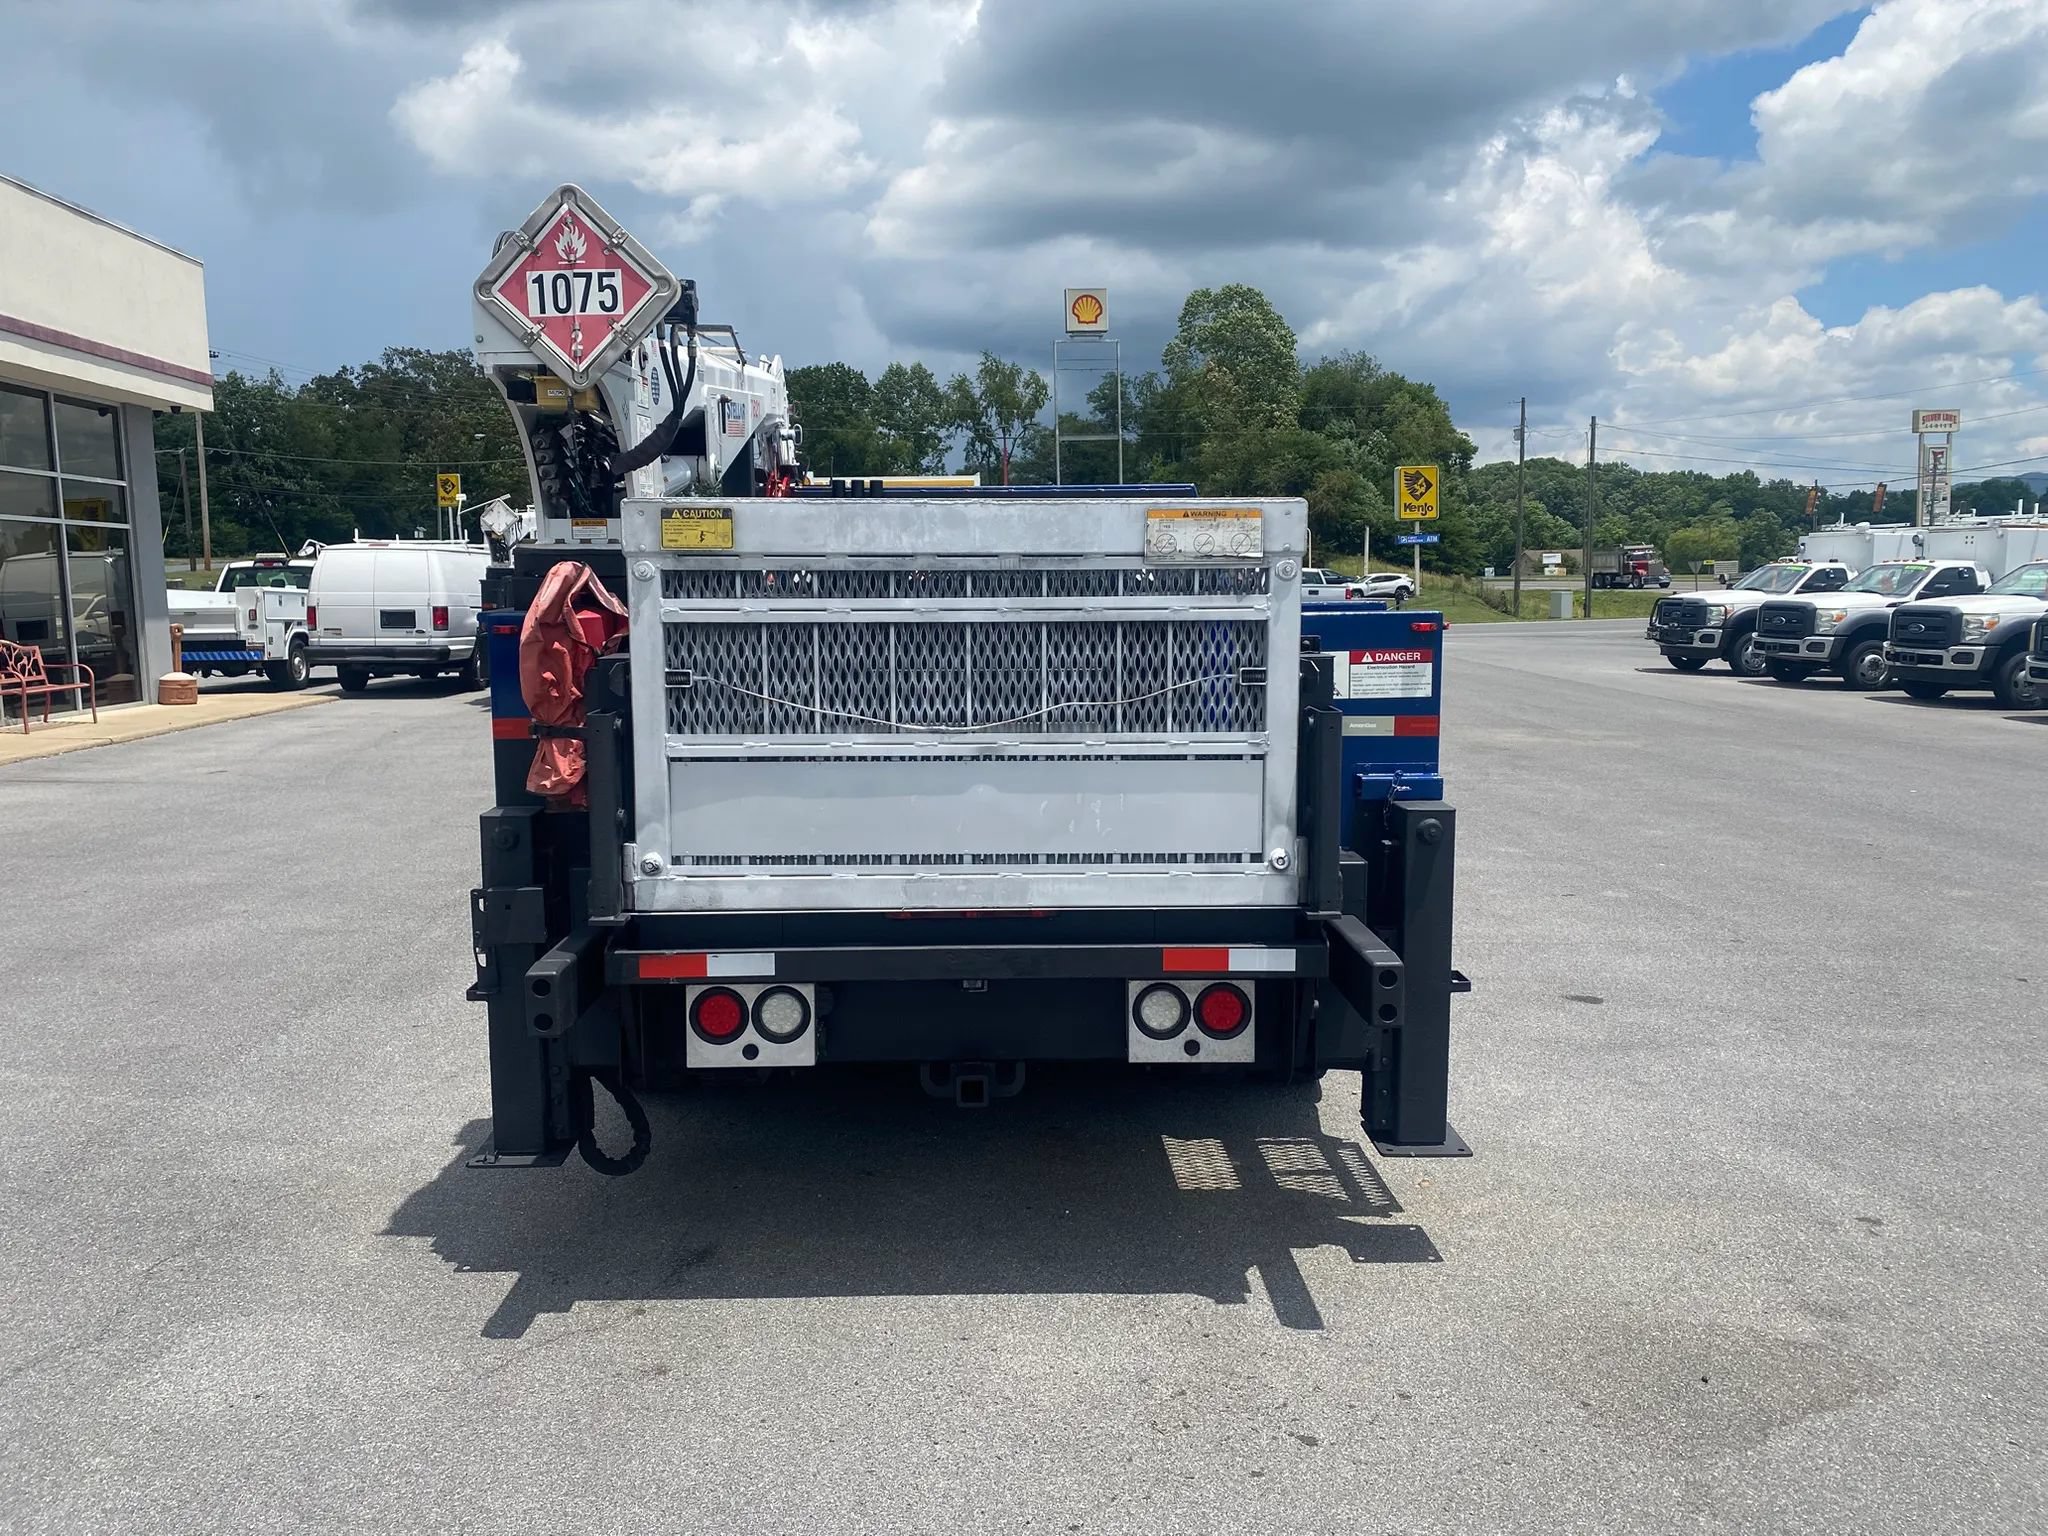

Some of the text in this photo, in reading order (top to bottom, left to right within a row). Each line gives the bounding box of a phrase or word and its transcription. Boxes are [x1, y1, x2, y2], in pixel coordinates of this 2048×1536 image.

[531, 271, 619, 315] 1075
[682, 509, 723, 519] CAUTION
[1375, 652, 1421, 662] DANGER
